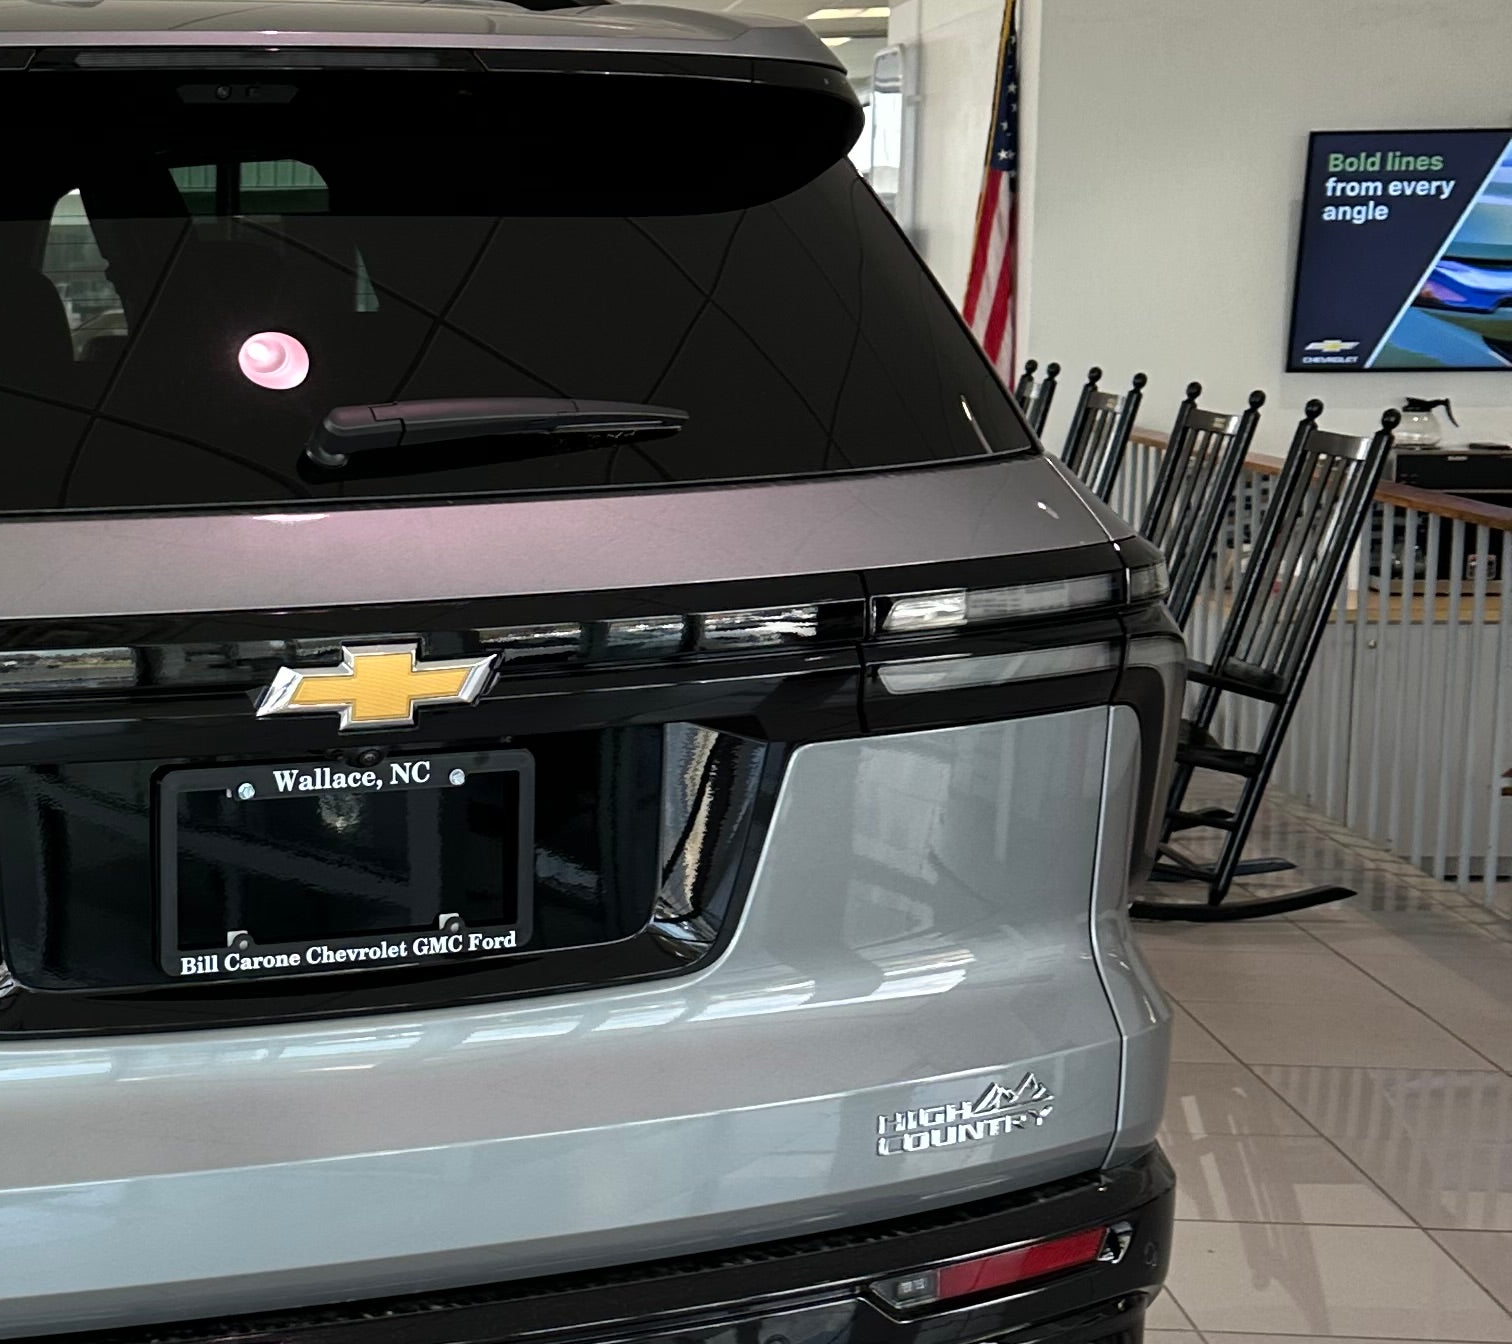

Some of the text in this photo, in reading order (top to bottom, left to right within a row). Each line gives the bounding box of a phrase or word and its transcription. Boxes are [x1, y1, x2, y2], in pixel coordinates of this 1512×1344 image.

[1328, 152, 1444, 172] Bold lines
[1325, 177, 1455, 199] from every
[1322, 201, 1389, 224] angle
[273, 761, 431, 792] Wallace, NC
[180, 931, 517, 976] Bill Carone Chevrolet GMC Ford
[877, 1100, 973, 1135] HIGH
[877, 1106, 1054, 1156] COUNTRY
